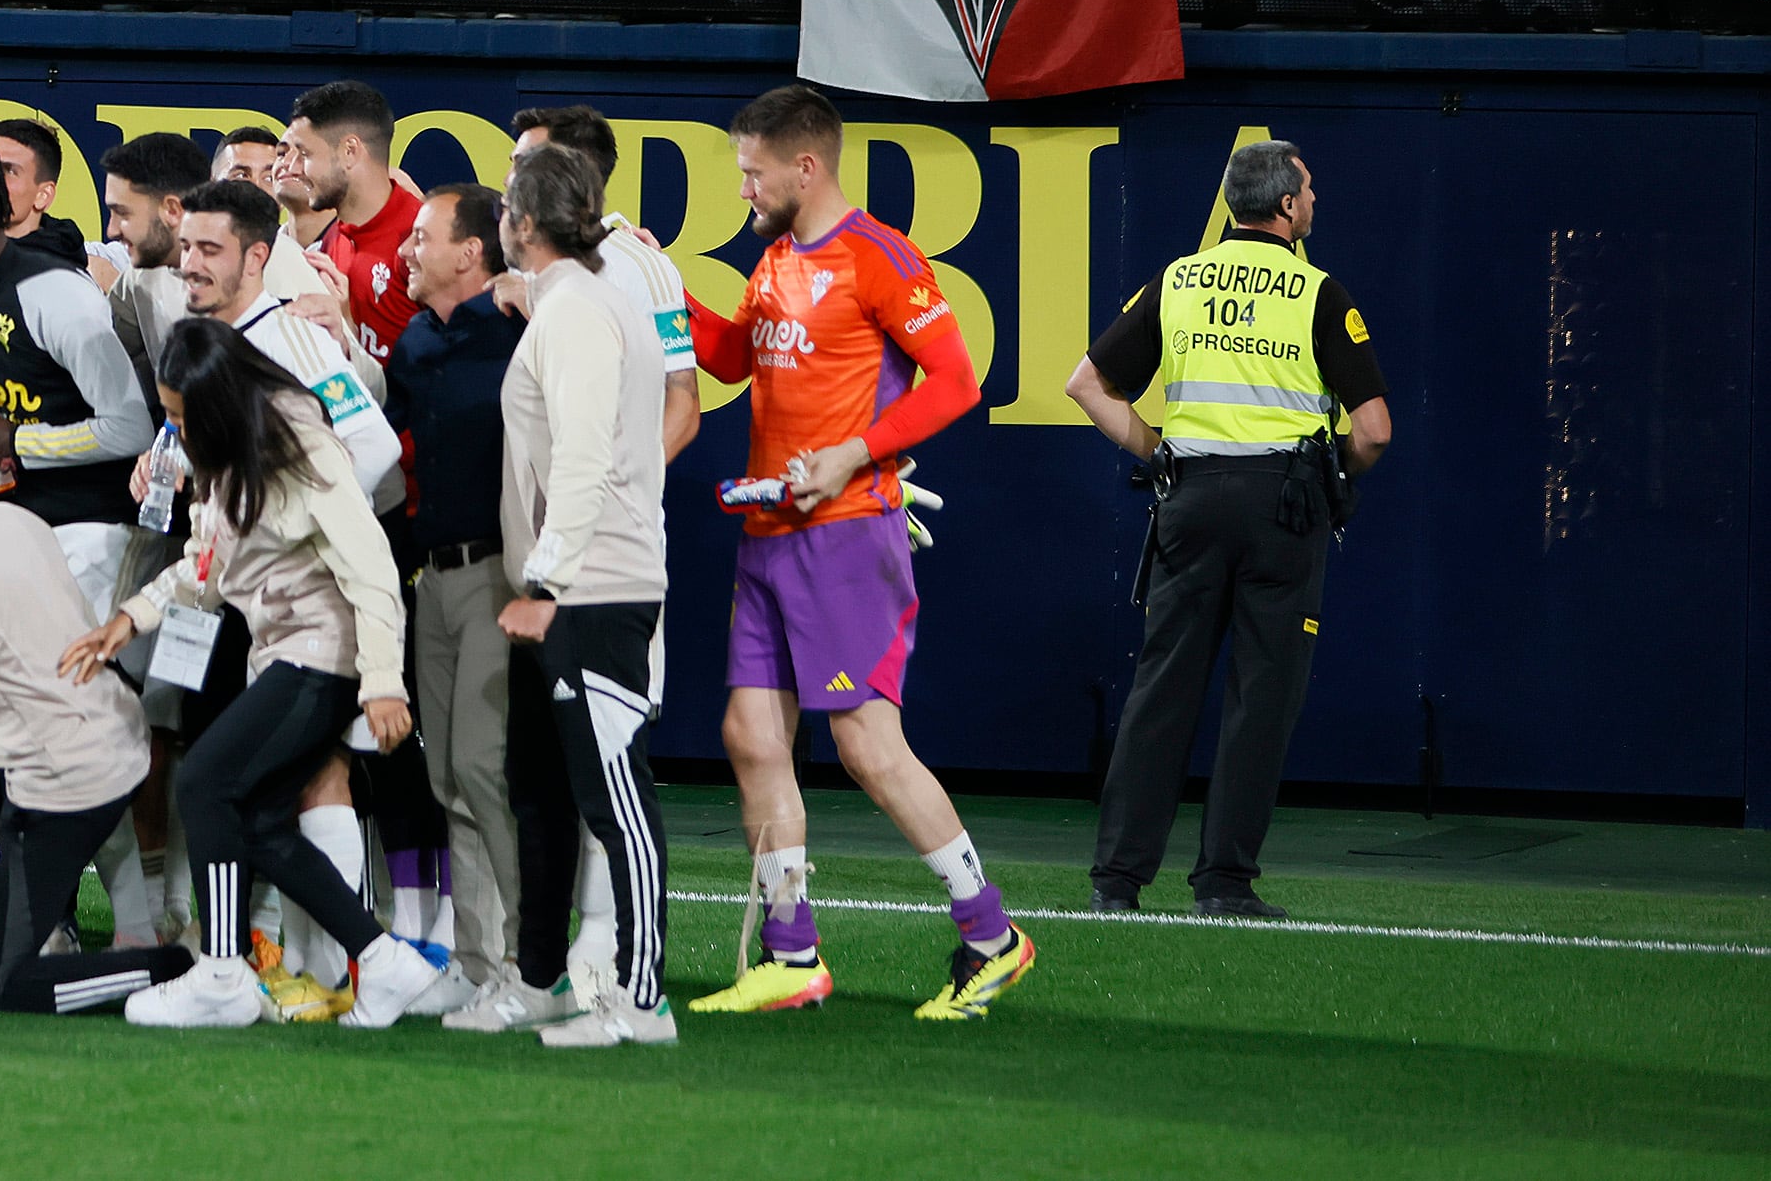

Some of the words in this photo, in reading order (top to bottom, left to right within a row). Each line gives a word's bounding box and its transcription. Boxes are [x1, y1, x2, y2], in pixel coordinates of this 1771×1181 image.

[1172, 262, 1306, 301] SEGURIDAD
[1203, 296, 1256, 328] 104
[752, 317, 816, 354] iner
[1191, 332, 1301, 361] PROSEGUR
